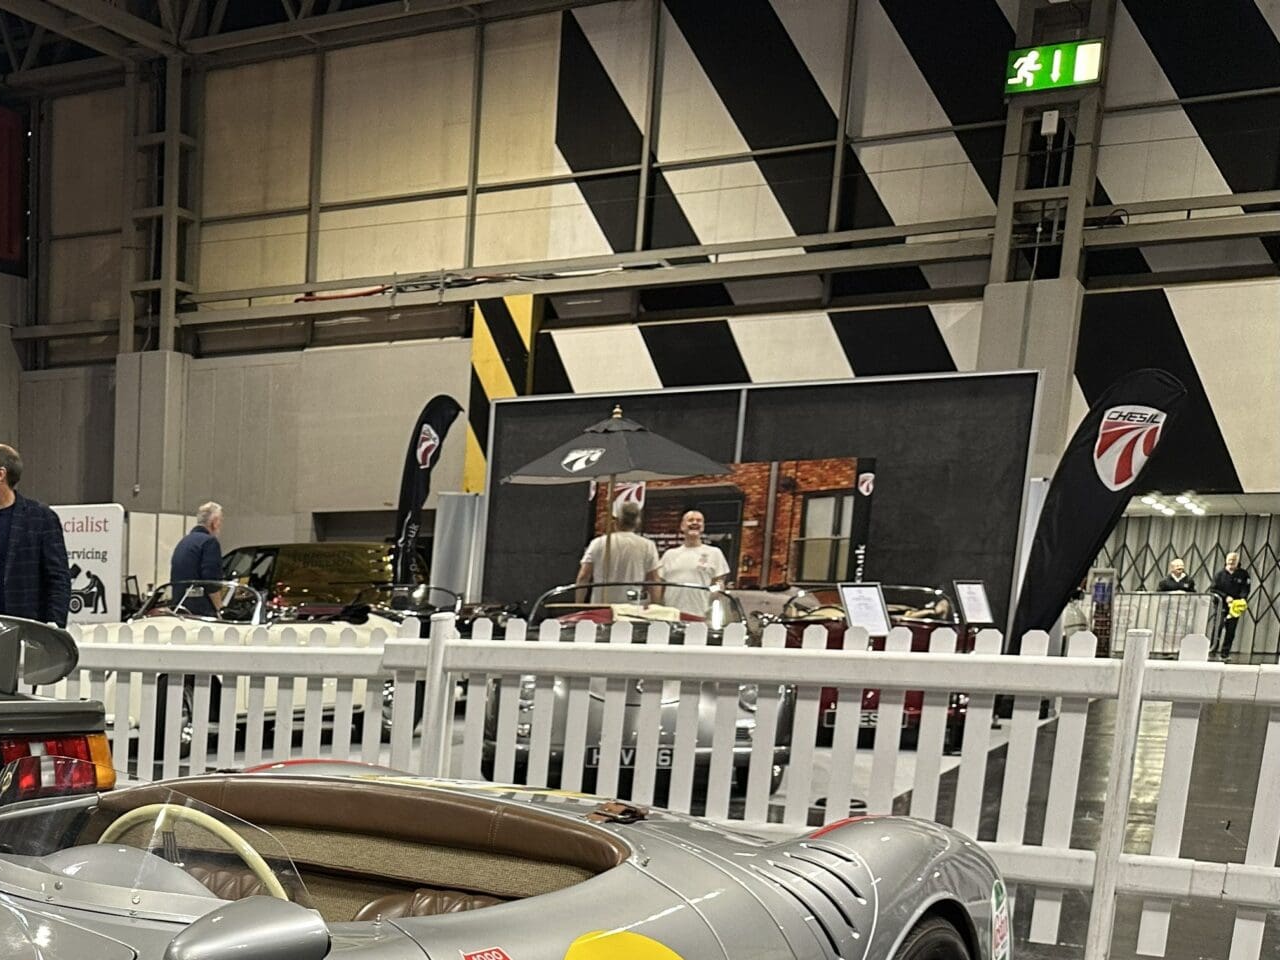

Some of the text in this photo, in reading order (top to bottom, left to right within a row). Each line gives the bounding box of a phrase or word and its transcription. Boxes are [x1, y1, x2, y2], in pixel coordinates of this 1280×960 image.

[1107, 411, 1160, 424] CHESIL
[63, 517, 109, 534] cialist
[67, 549, 108, 562] ervicing
